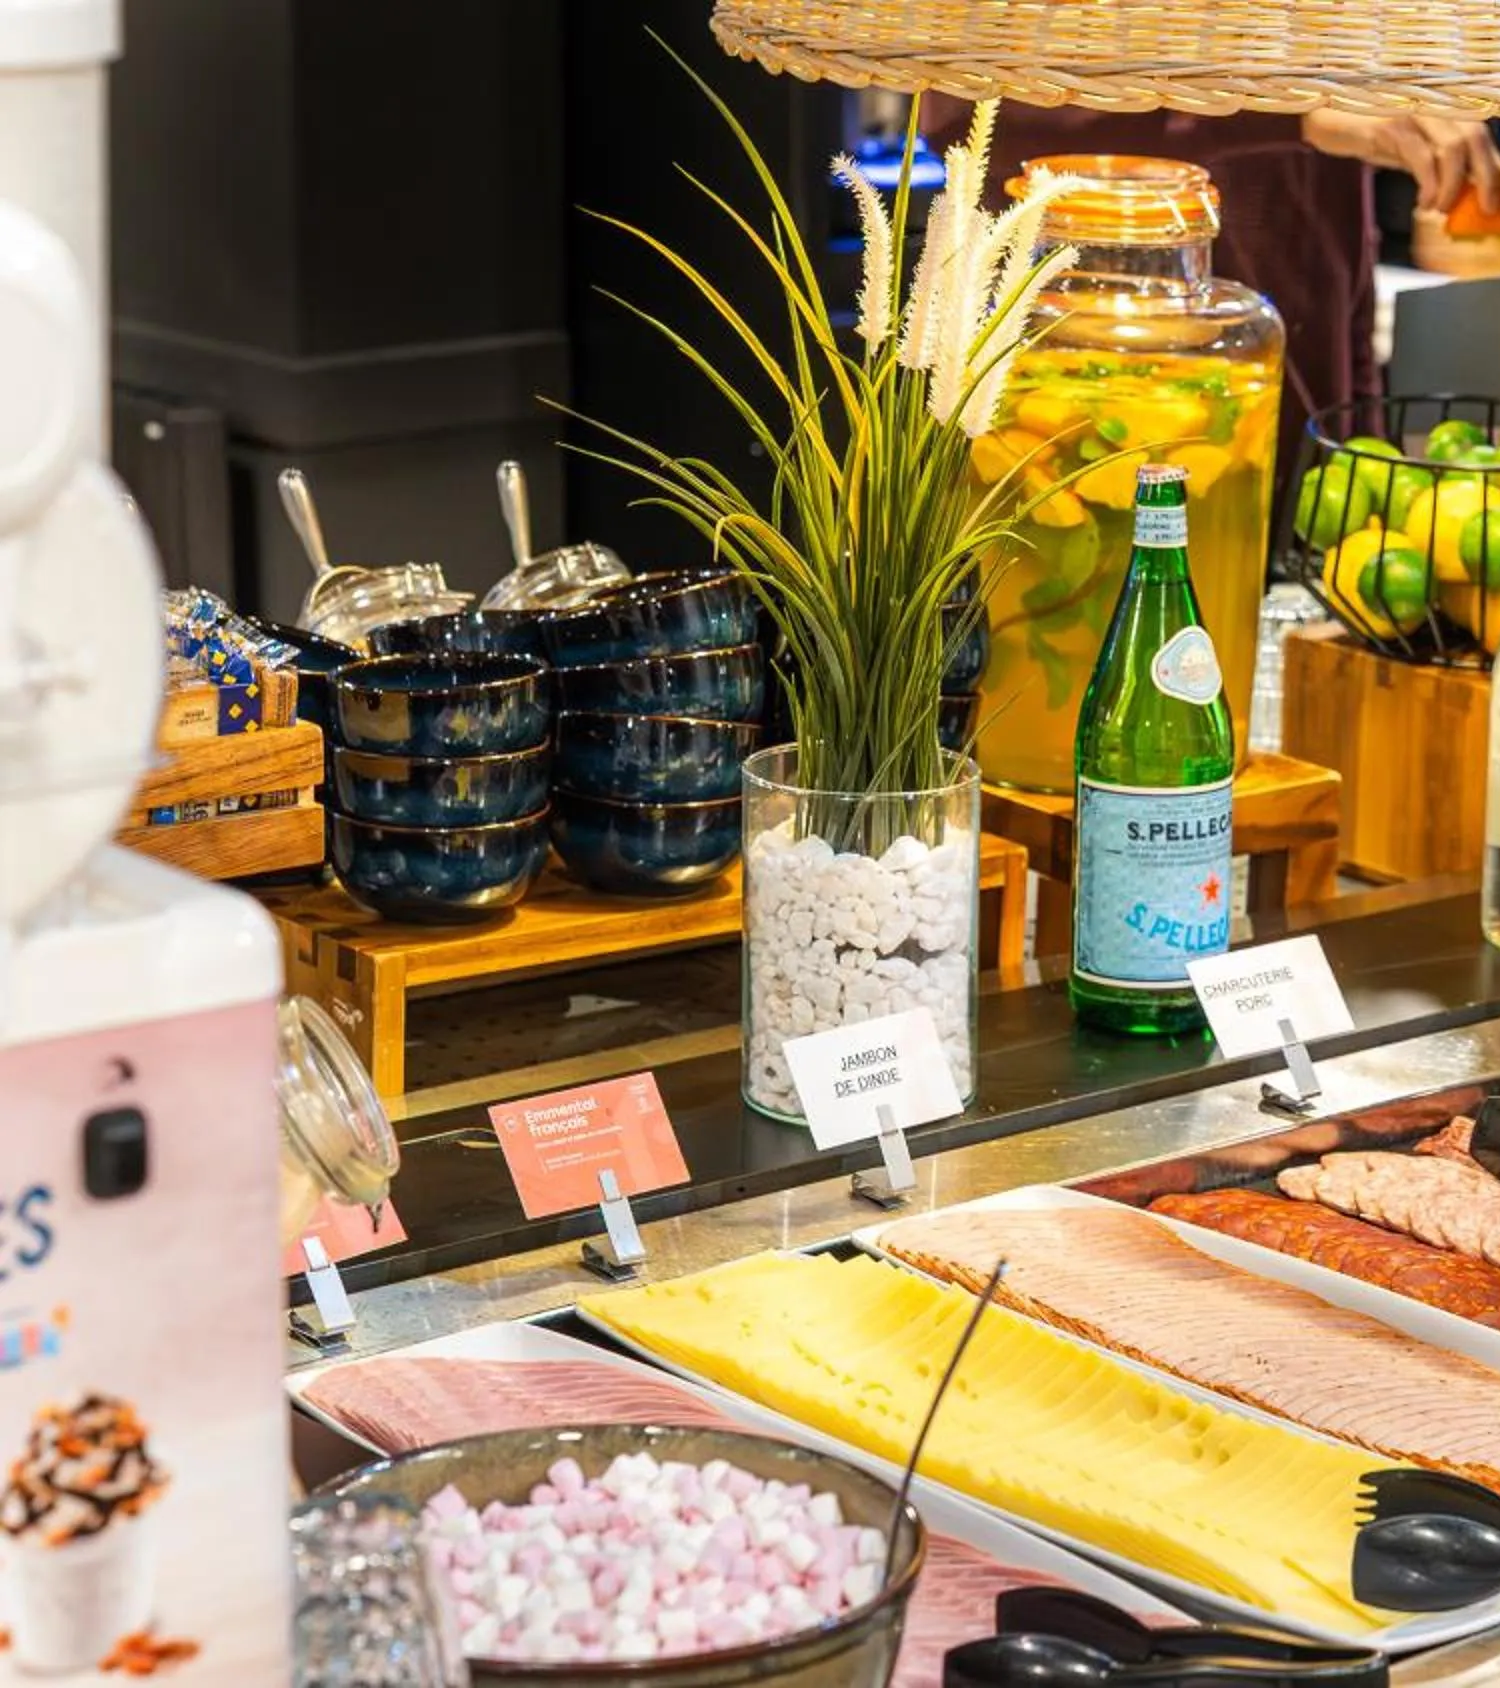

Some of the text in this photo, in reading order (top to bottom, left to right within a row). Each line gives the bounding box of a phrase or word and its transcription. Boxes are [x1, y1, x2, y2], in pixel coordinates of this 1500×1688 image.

[1203, 966, 1295, 998] CHARCUTERIE
[1235, 993, 1273, 1013] PORC
[840, 1045, 898, 1071] JAMBON
[833, 1067, 902, 1098] DE DINDE
[524, 1096, 599, 1125] Emmental
